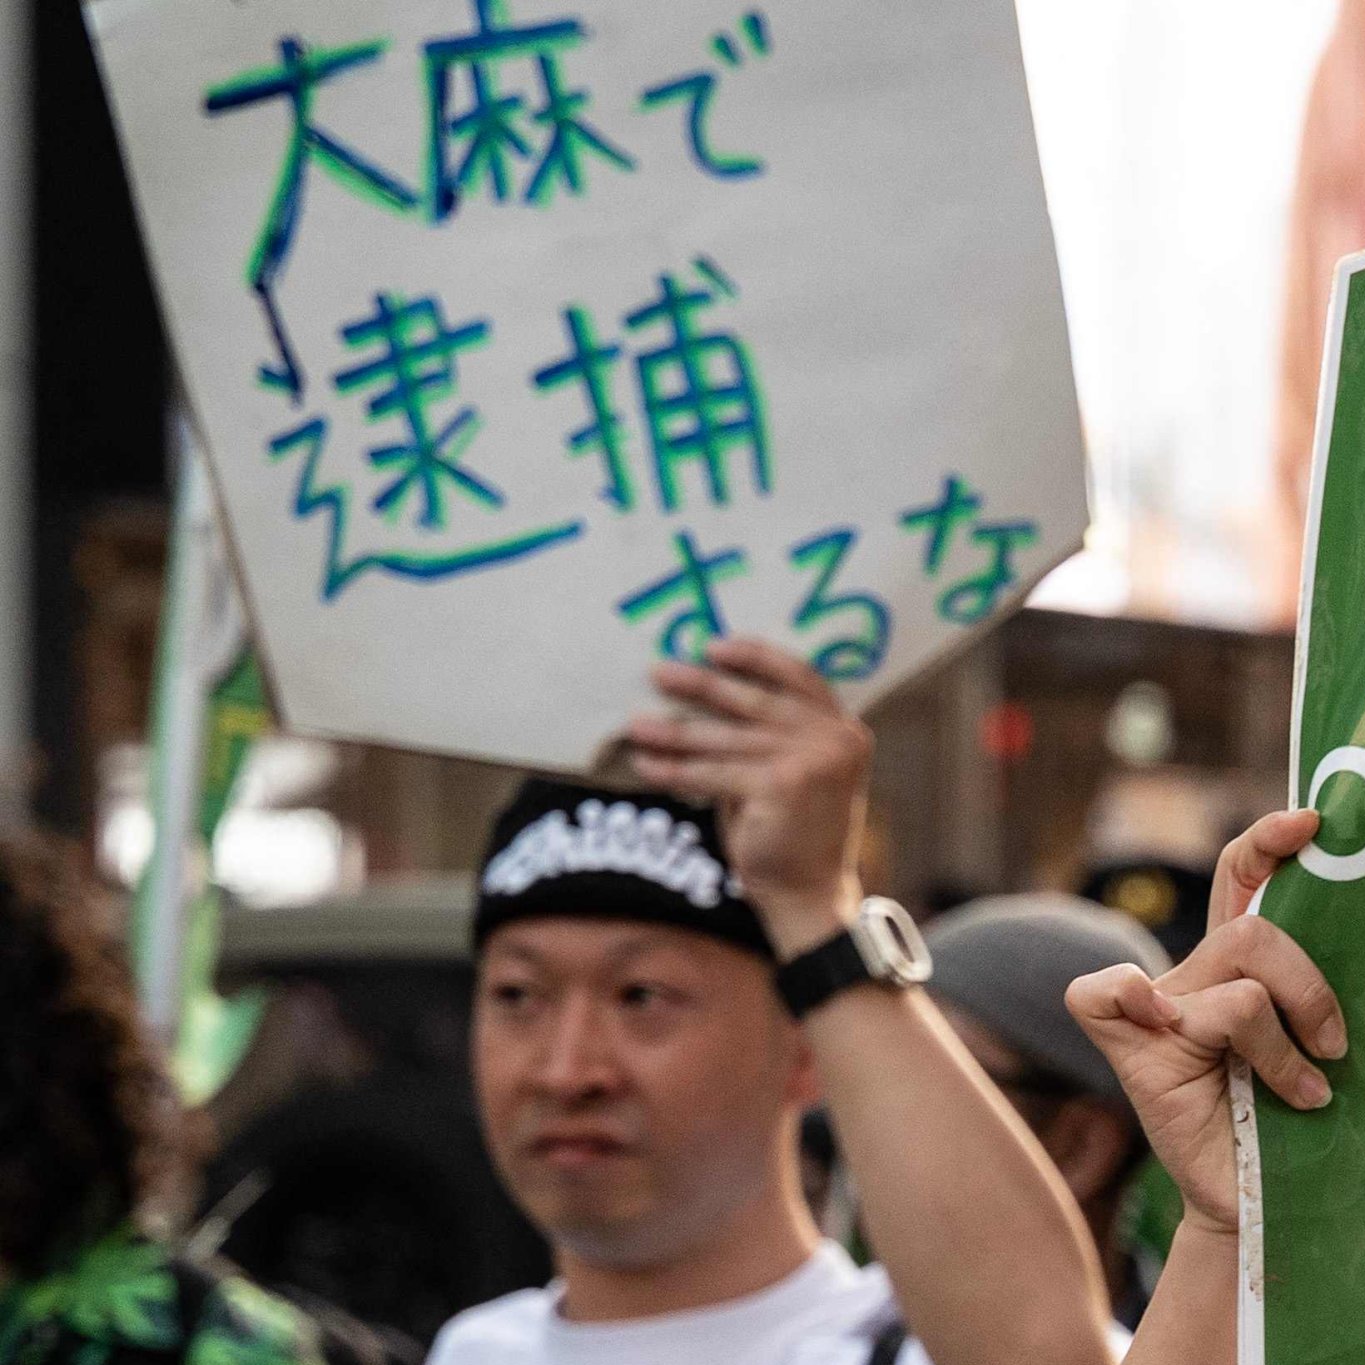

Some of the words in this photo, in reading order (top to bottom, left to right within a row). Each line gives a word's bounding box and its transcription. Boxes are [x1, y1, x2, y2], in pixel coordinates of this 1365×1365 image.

[205, 0, 771, 288] 大麻で
[256, 256, 773, 602] 逮捕
[616, 473, 1038, 680] するな
